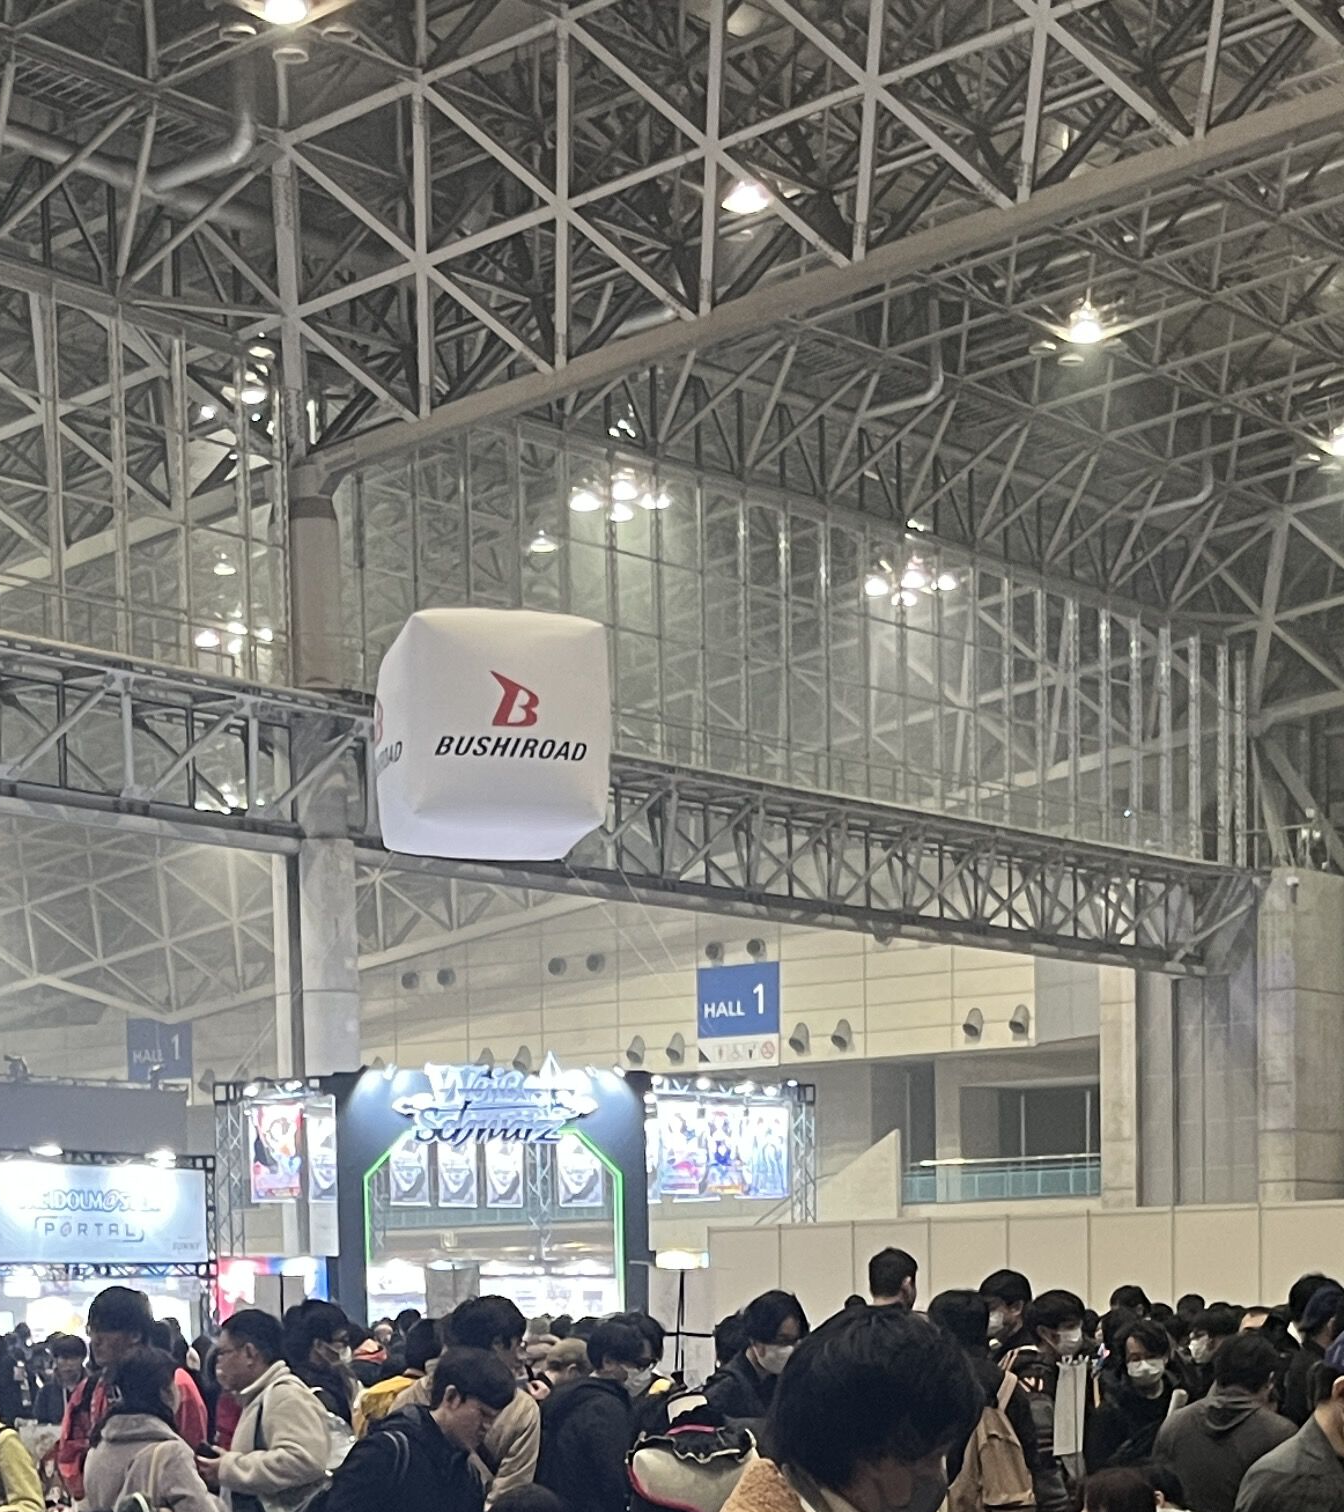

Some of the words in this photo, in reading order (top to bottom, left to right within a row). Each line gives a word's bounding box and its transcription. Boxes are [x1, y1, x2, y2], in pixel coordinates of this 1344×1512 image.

[435, 736, 587, 761] BUSHIROAD
[703, 999, 746, 1019] HALL
[752, 983, 765, 1015] 1
[132, 1048, 164, 1065] HALL
[170, 1034, 181, 1061] 1
[44, 1221, 137, 1238] PORTAL
